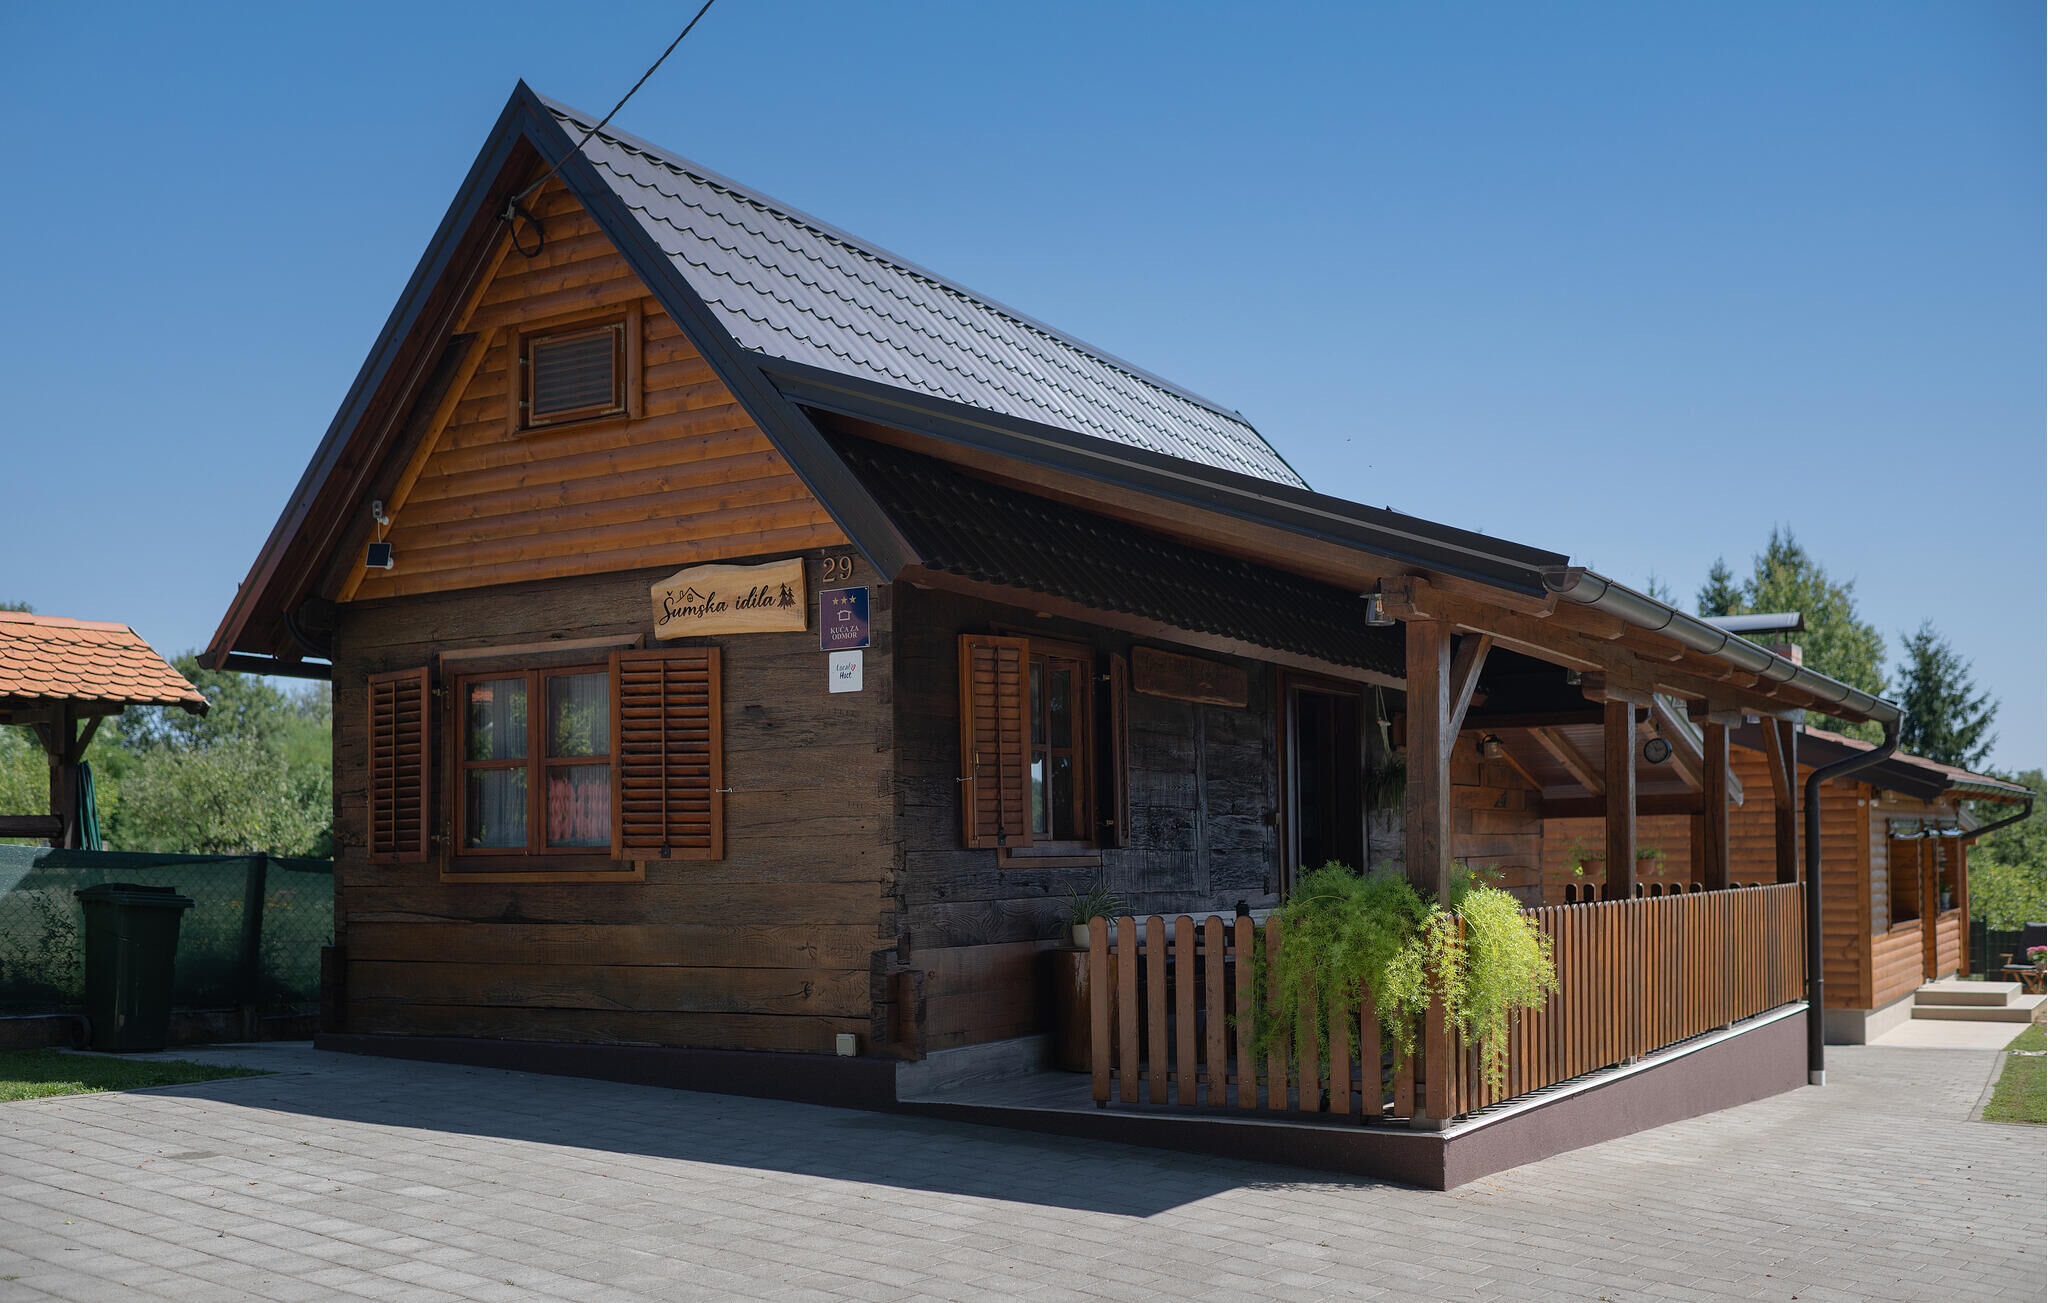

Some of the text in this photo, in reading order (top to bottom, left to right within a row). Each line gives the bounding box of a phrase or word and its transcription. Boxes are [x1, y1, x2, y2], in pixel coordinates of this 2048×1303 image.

[823, 556, 853, 582] 29
[659, 585, 776, 625] Šumska idila
[830, 625, 859, 635] KUĆA ZA
[831, 632, 858, 641] ODMOR
